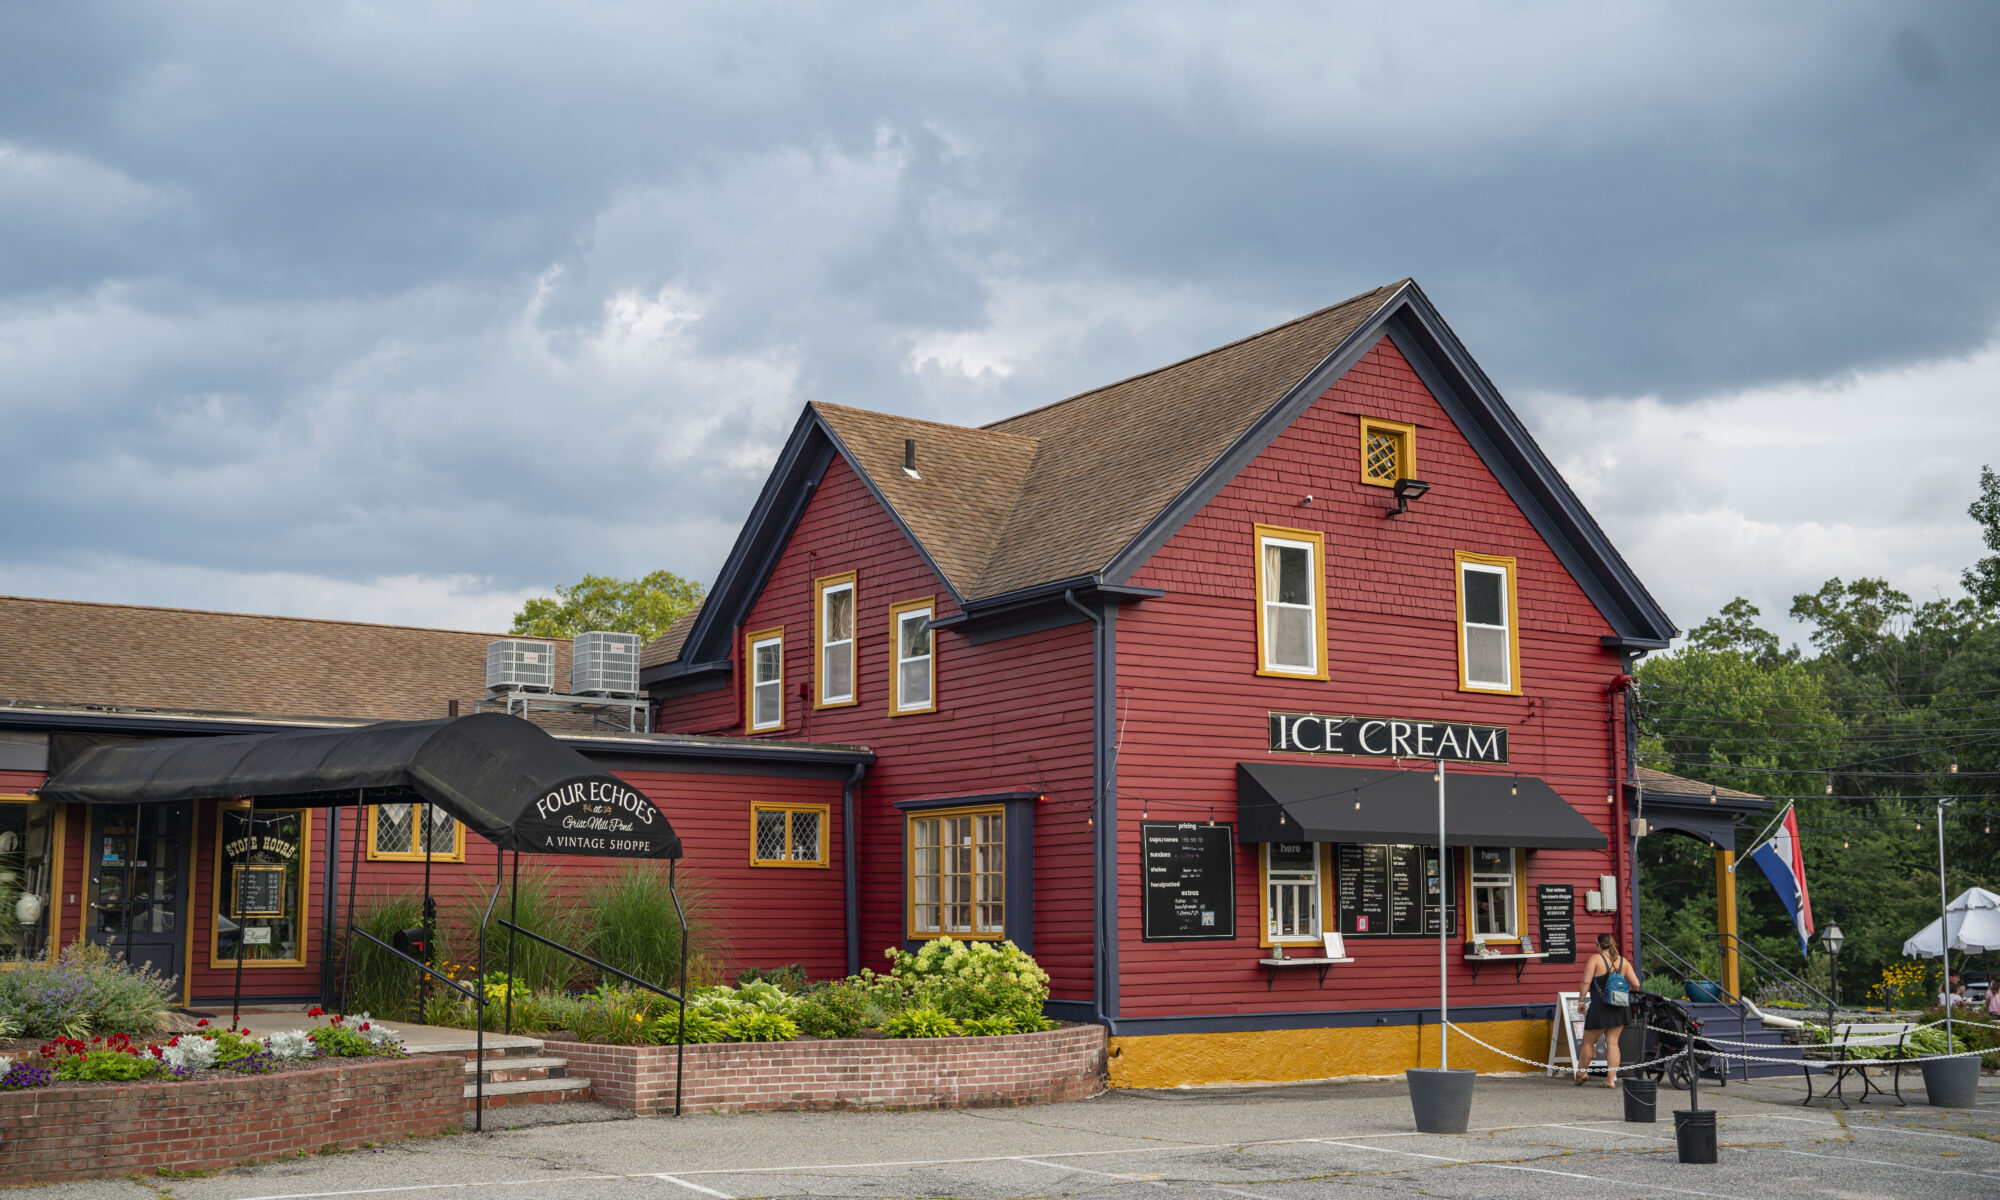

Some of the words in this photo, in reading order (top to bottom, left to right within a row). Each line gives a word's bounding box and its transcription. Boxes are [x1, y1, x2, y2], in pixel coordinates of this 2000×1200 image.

[1279, 715, 1344, 752] ICE
[1358, 720, 1500, 761] CREAM
[536, 782, 587, 820] FOUR
[590, 782, 657, 825] ECHOES
[593, 804, 603, 814] at
[562, 815, 588, 830] Grist
[587, 816, 609, 831] Mill
[608, 818, 633, 832] Pond
[262, 836, 297, 859] HOURS
[545, 836, 554, 847] A
[557, 836, 605, 849] VINTAGE
[610, 839, 650, 852] SHOPPE
[1280, 843, 1301, 853] here
[1481, 851, 1500, 860] here
